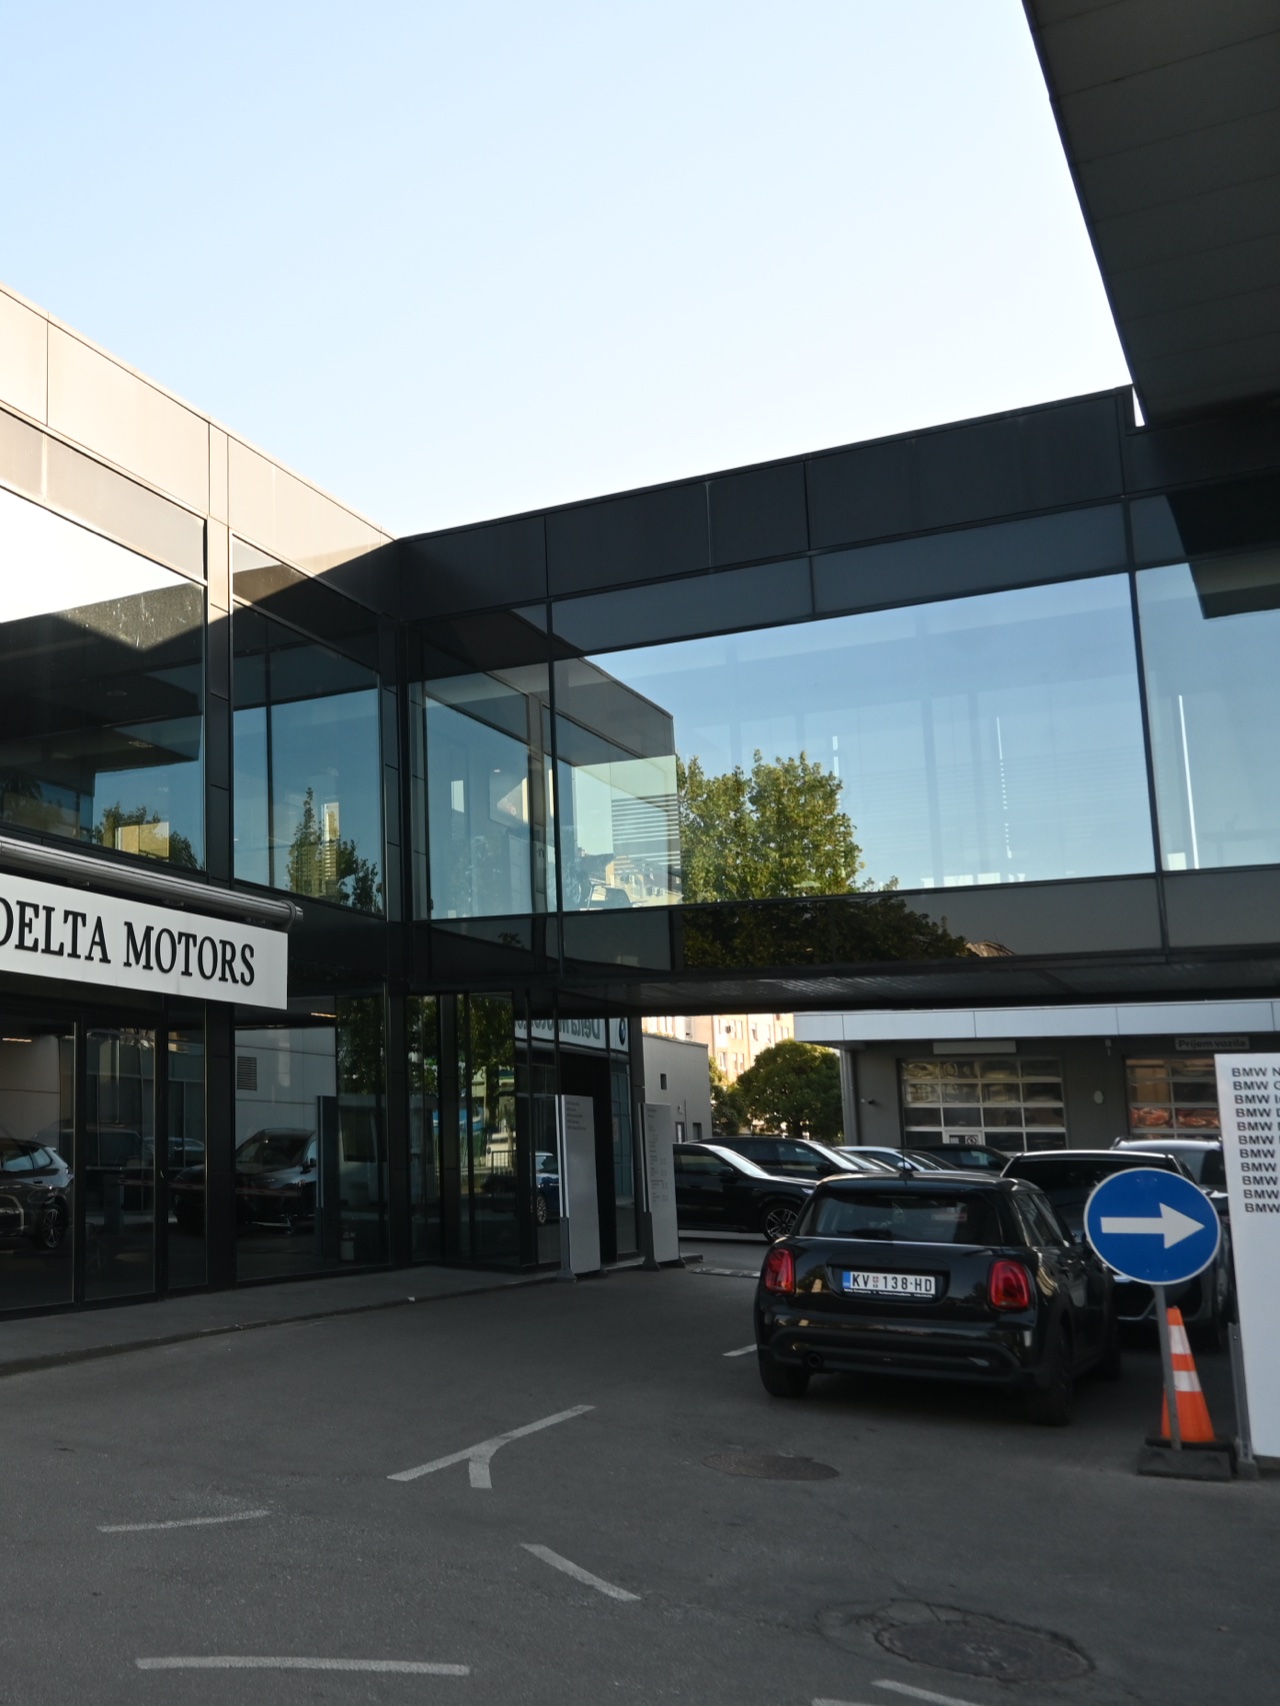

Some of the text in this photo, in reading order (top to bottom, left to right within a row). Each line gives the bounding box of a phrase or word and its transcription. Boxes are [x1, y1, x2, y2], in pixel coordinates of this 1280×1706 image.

[122, 921, 256, 986] MOTORS
[1179, 1038, 1246, 1049] Prijem vozila
[1232, 1067, 1267, 1077] BMW
[1233, 1081, 1268, 1091] BMW
[1234, 1094, 1270, 1104] BMW
[1236, 1108, 1271, 1118] BMW
[1237, 1121, 1273, 1131] BMW
[1238, 1135, 1274, 1145] BMW
[1239, 1149, 1275, 1158] BMW
[1241, 1162, 1277, 1172] BMW
[1242, 1175, 1278, 1186] BMW
[1243, 1189, 1279, 1199] BMW
[1245, 1203, 1280, 1213] BMW
[852, 1273, 870, 1288] KV
